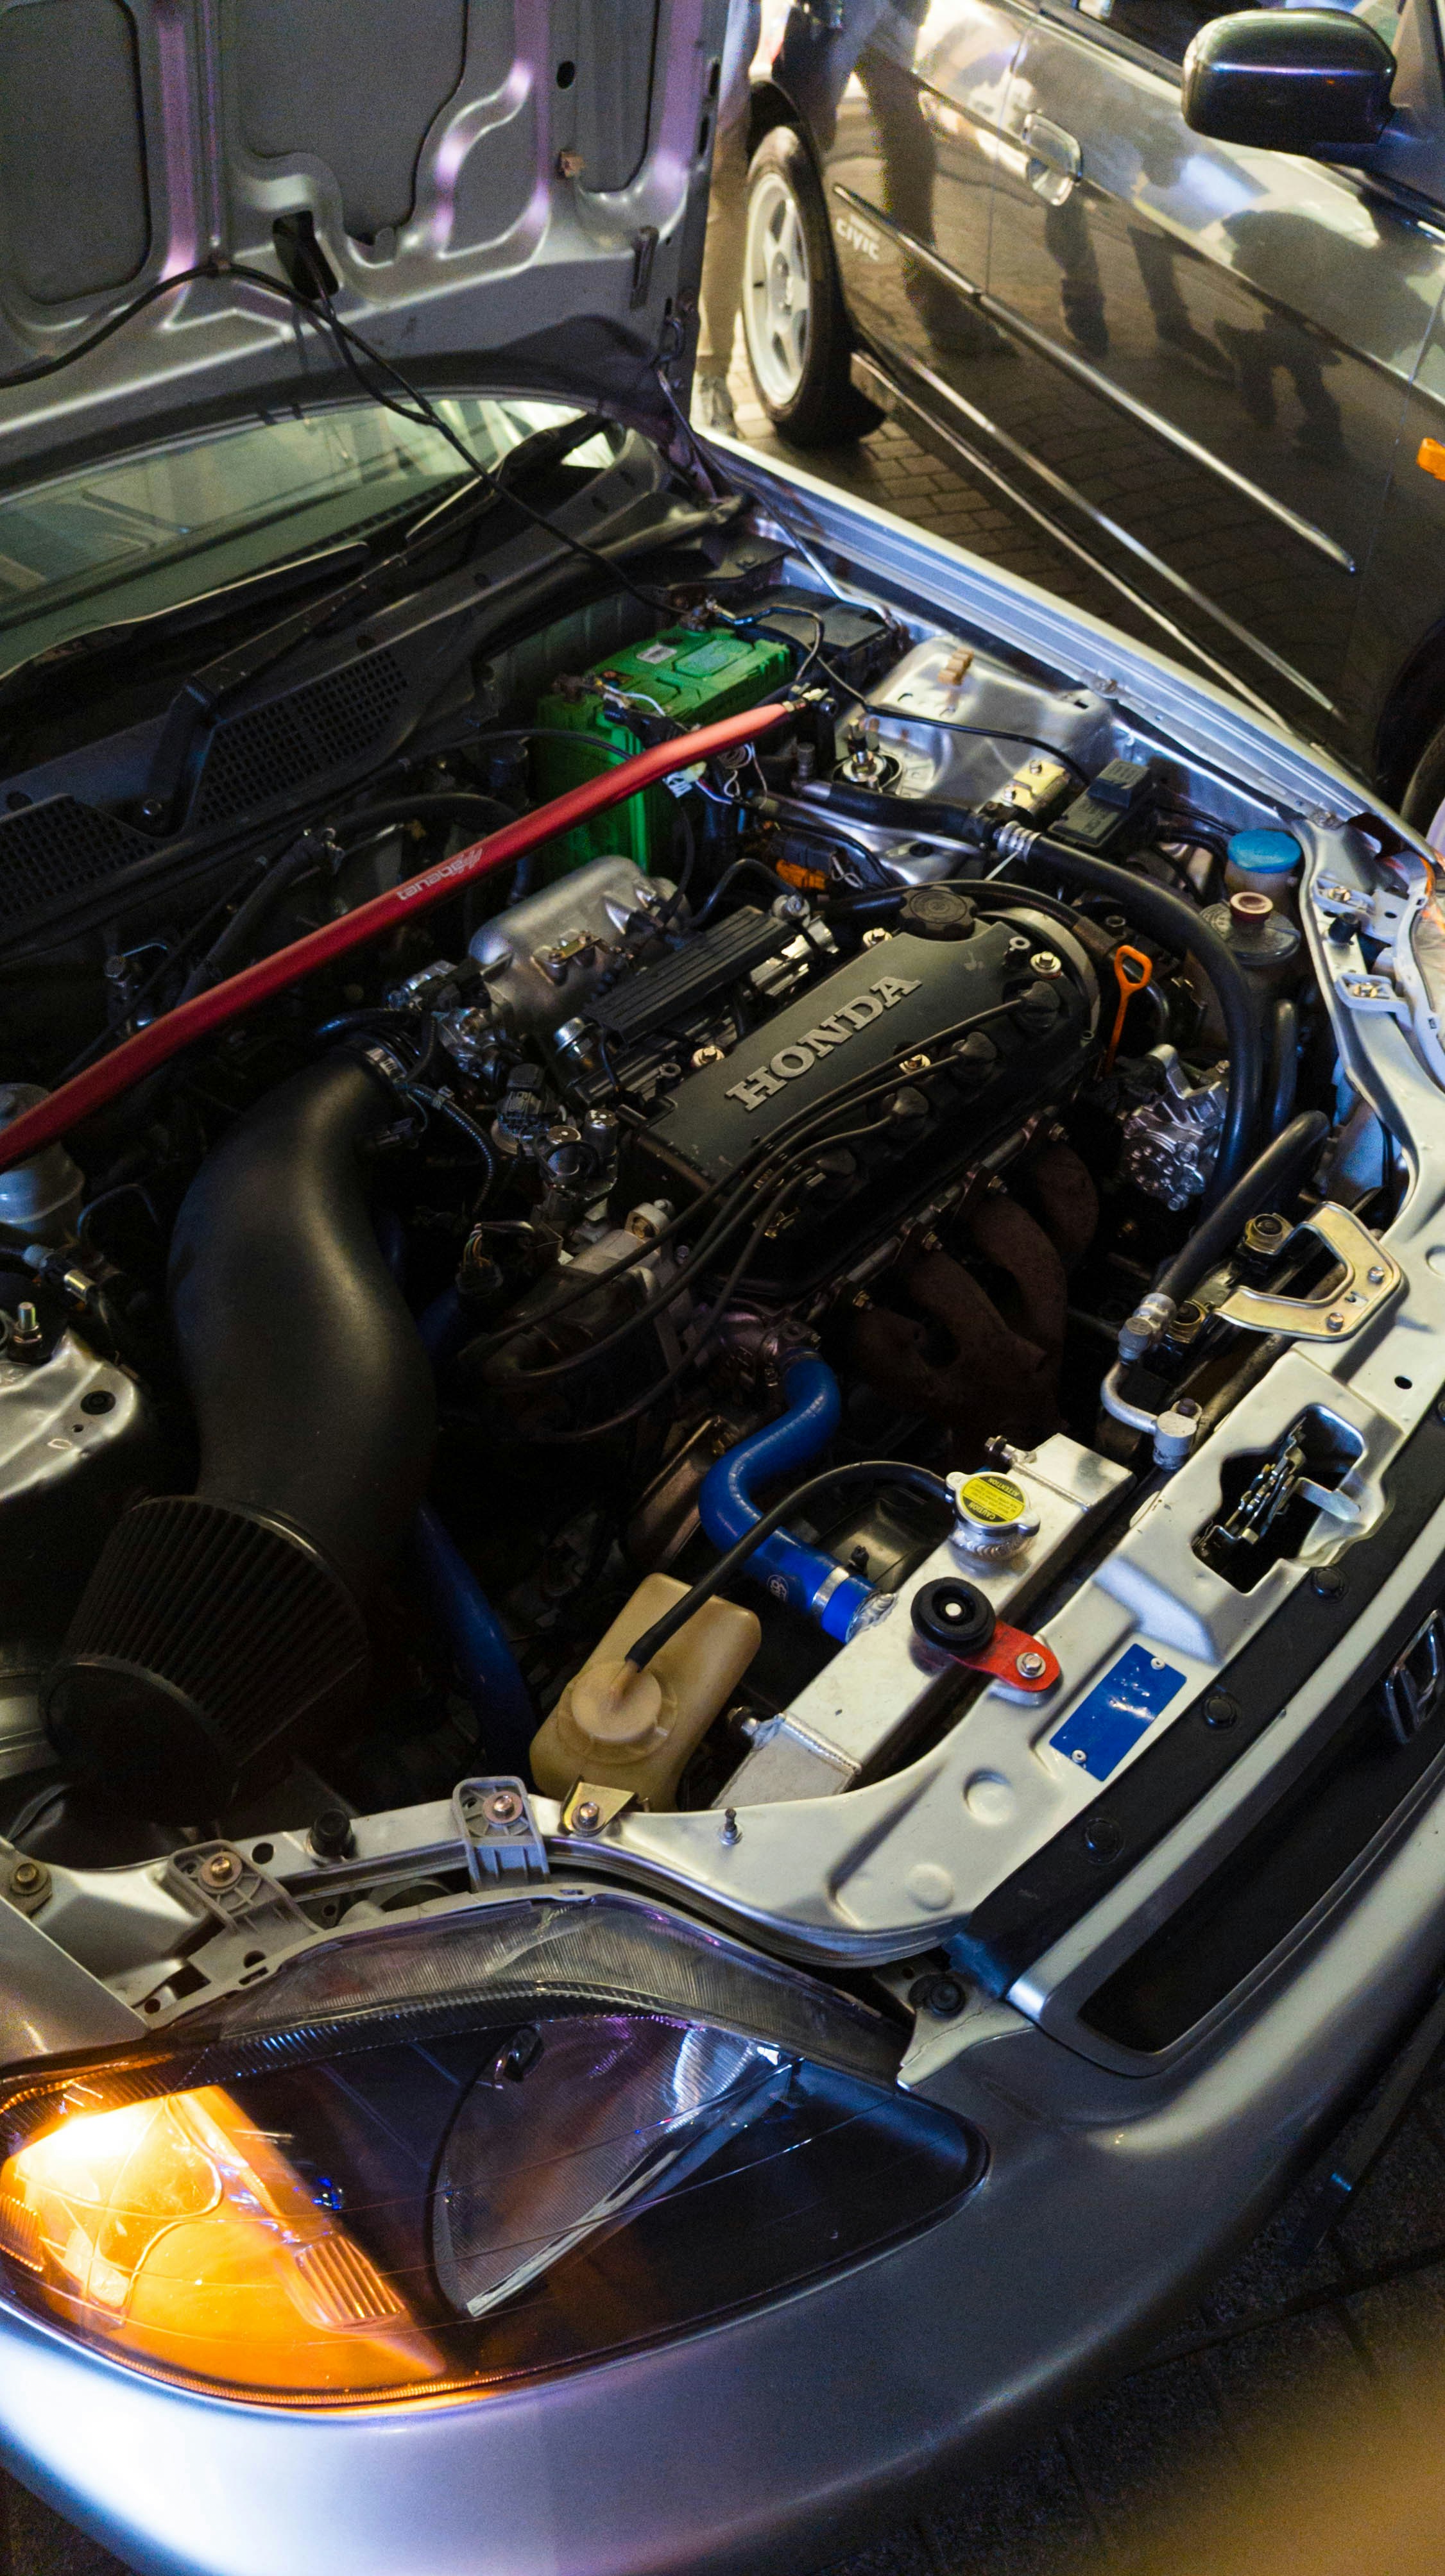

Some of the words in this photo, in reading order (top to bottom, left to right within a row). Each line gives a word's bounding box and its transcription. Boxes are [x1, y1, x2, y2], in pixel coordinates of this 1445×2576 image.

[835, 217, 880, 261] CIVIC
[397, 857, 465, 901] tanabe
[725, 976, 923, 1112] HONDA
[988, 1477, 1020, 1497] ATTENTION
[968, 1501, 996, 1520] CAUTION
